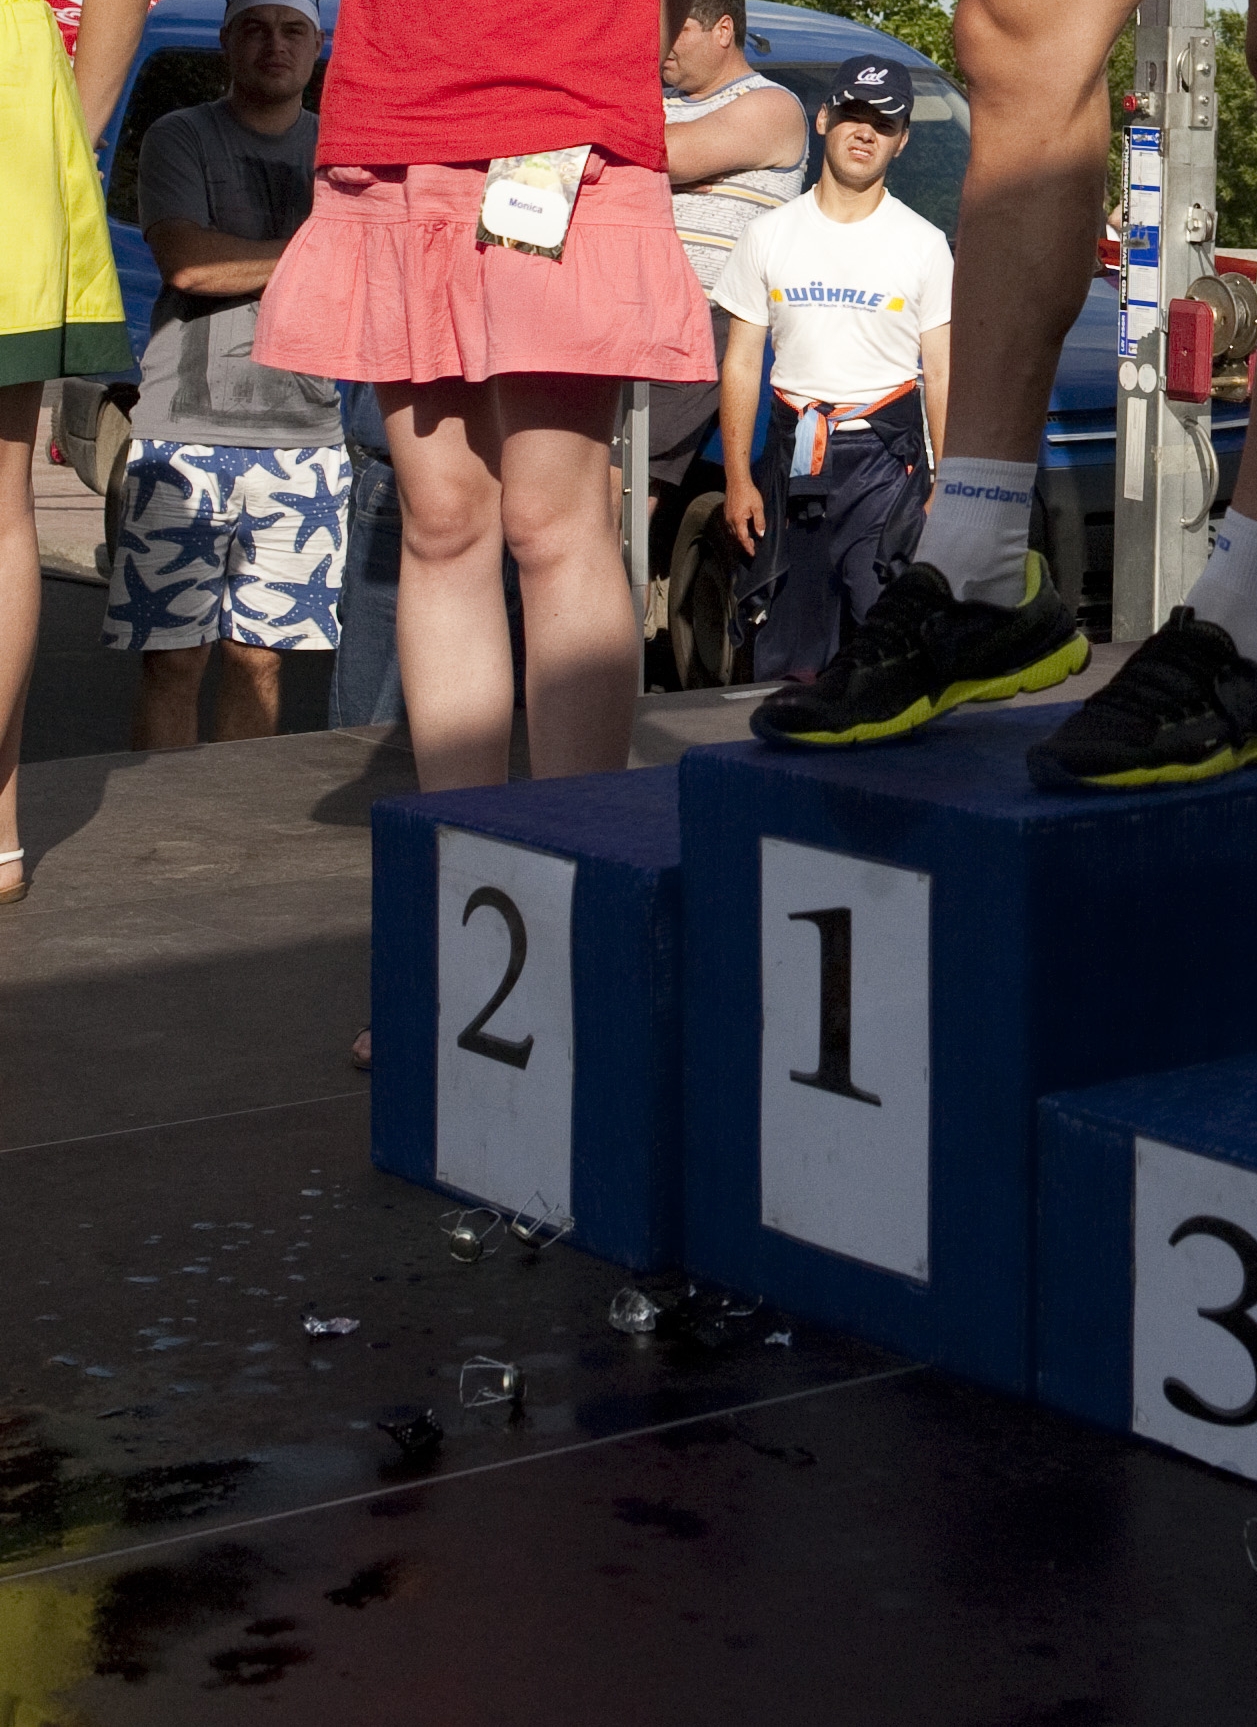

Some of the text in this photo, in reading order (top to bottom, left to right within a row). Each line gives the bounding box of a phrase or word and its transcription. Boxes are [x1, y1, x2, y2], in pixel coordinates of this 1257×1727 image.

[854, 67, 889, 85] Cal
[508, 197, 543, 214] Monica
[785, 281, 885, 307] WÖHRLE
[456, 884, 536, 1071] 2
[786, 906, 882, 1108] 1
